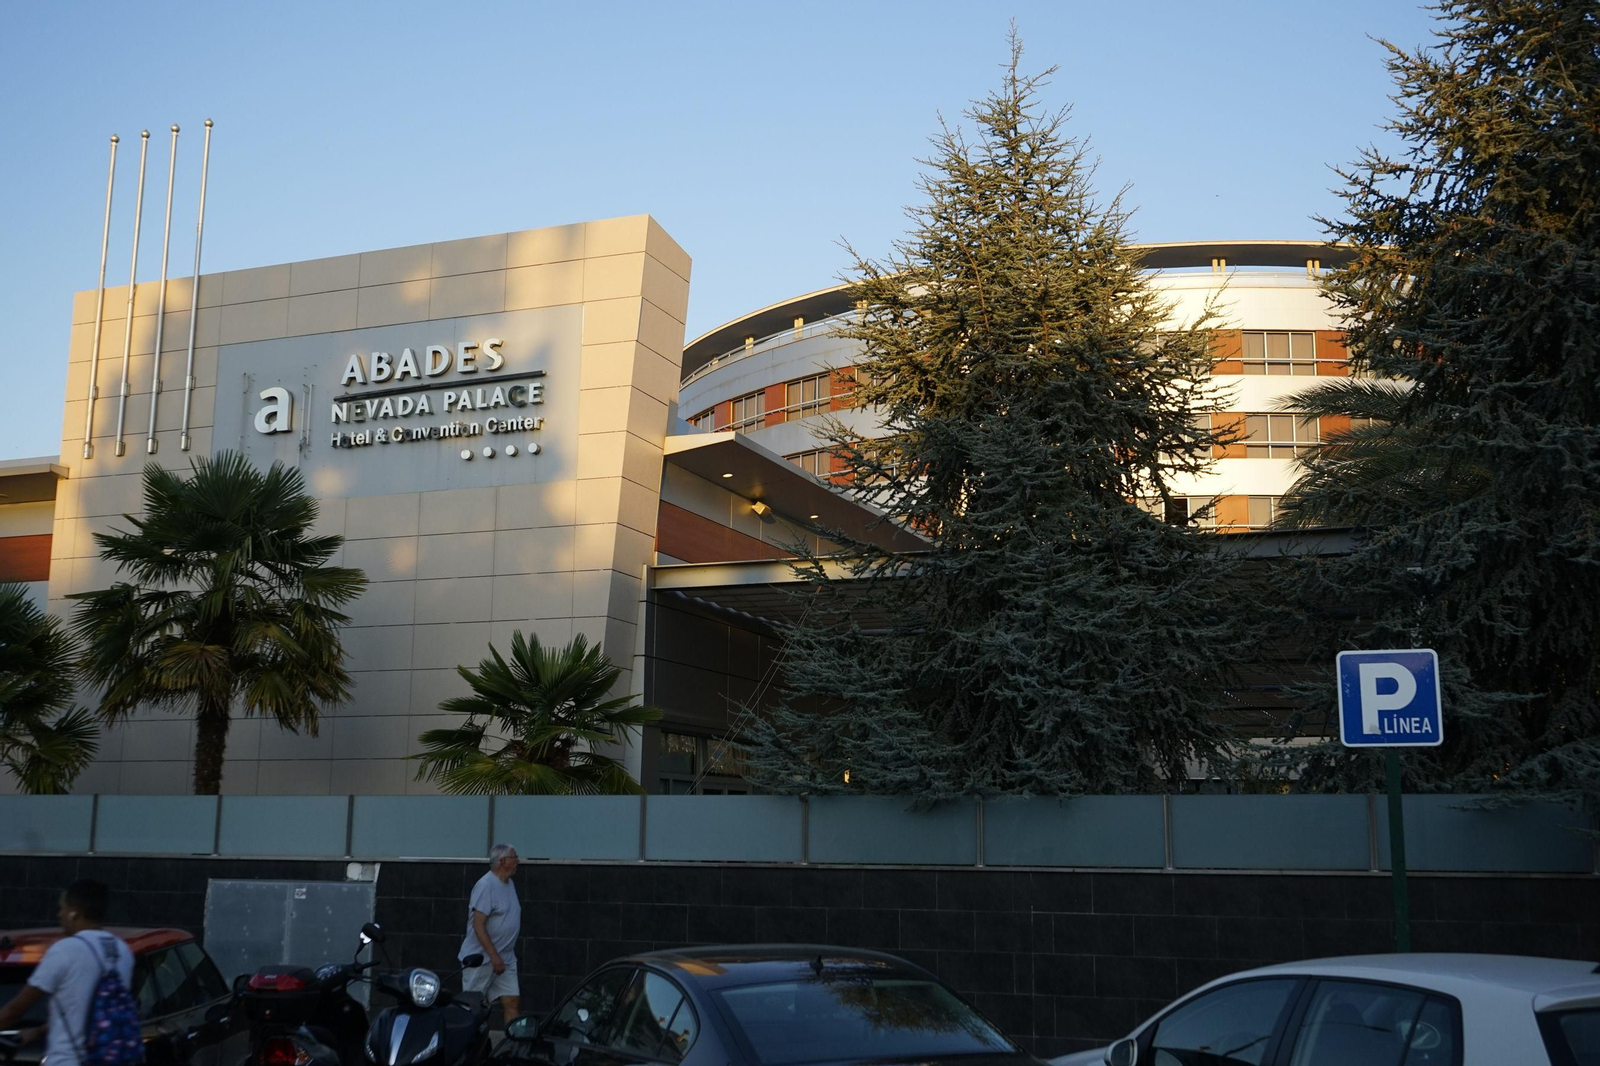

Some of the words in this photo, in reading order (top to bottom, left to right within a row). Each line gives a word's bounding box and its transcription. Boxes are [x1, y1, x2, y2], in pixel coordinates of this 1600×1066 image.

[341, 338, 505, 385] ABADES
[254, 386, 293, 434] a
[331, 394, 434, 424] NEVADA
[443, 382, 545, 413] PALACE
[330, 429, 373, 449] Hotel
[375, 427, 390, 443] &
[391, 420, 482, 444] Convention
[485, 415, 546, 434] Center
[1359, 662, 1417, 735] P
[1383, 713, 1433, 734] LÍNEA
